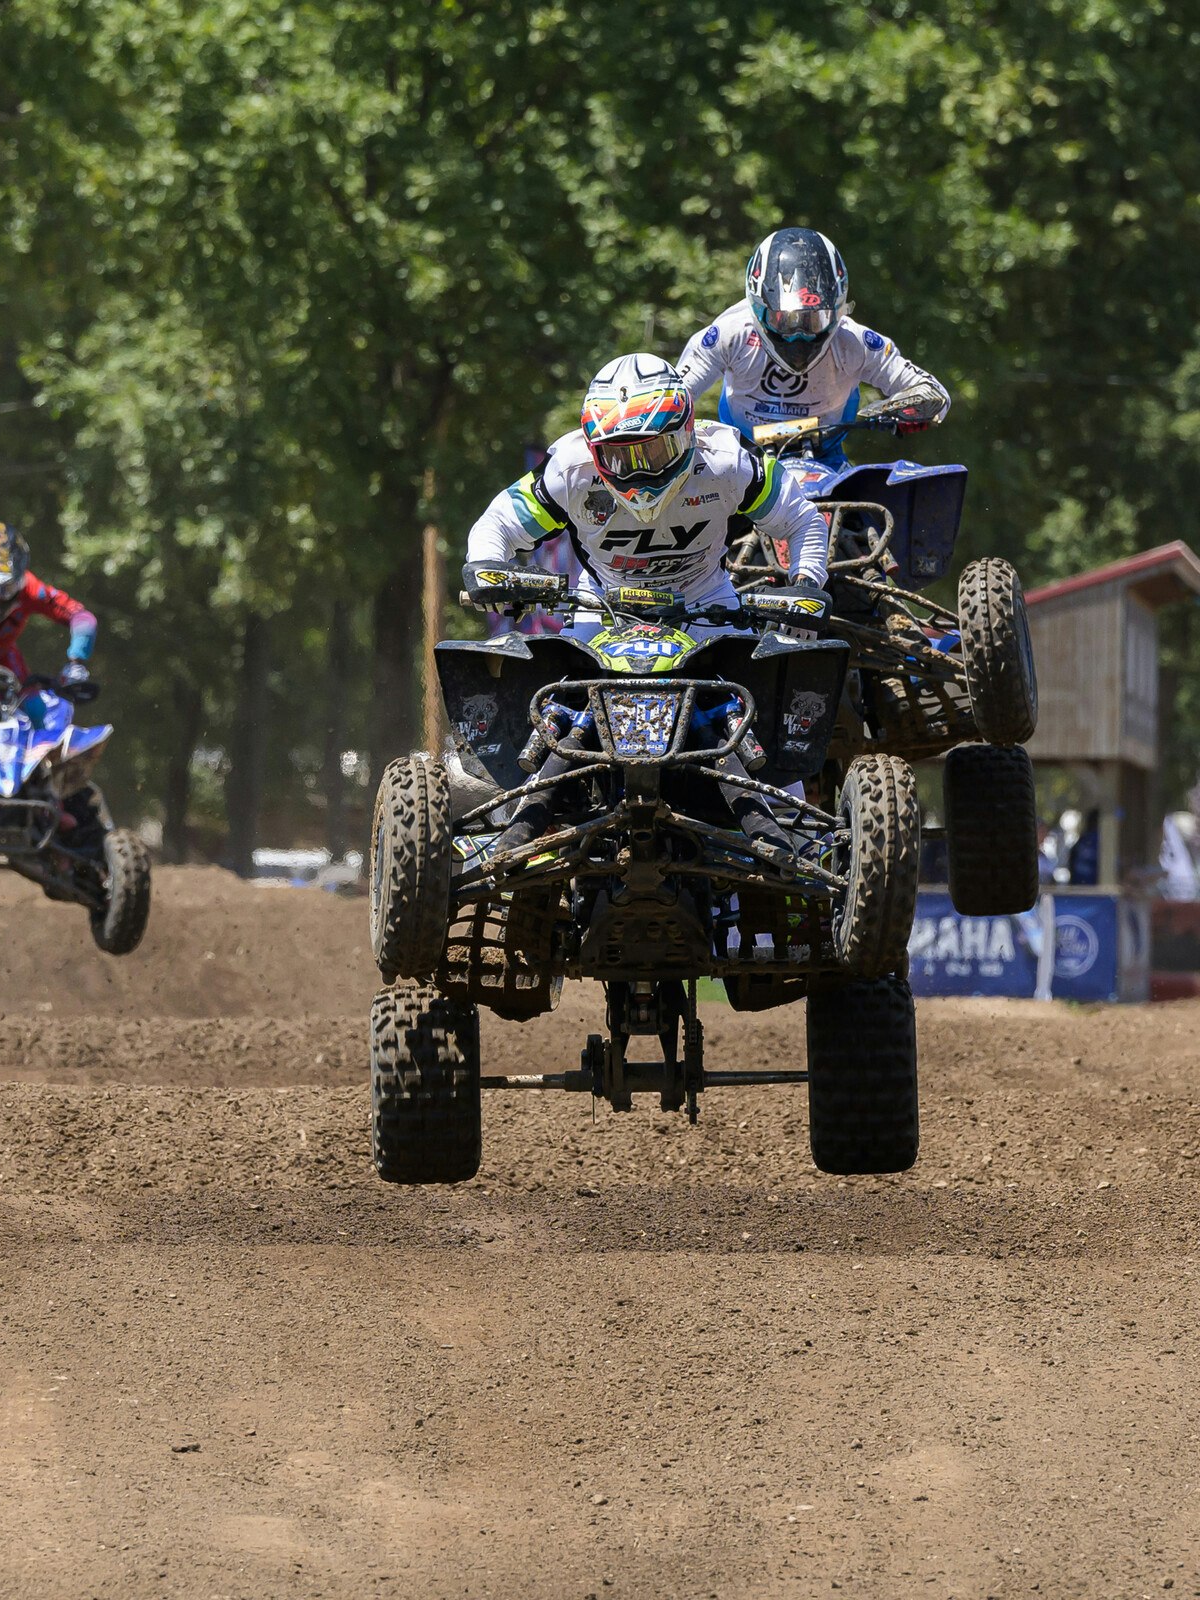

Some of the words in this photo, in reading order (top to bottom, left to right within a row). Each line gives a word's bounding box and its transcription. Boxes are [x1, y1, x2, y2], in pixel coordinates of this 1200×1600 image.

[767, 405, 808, 415] YAMAHA
[618, 418, 642, 431] SHOEI
[681, 495, 706, 507] AMA
[599, 519, 712, 555] FLY
[608, 641, 672, 656] 741
[907, 917, 1015, 961] MAHA
